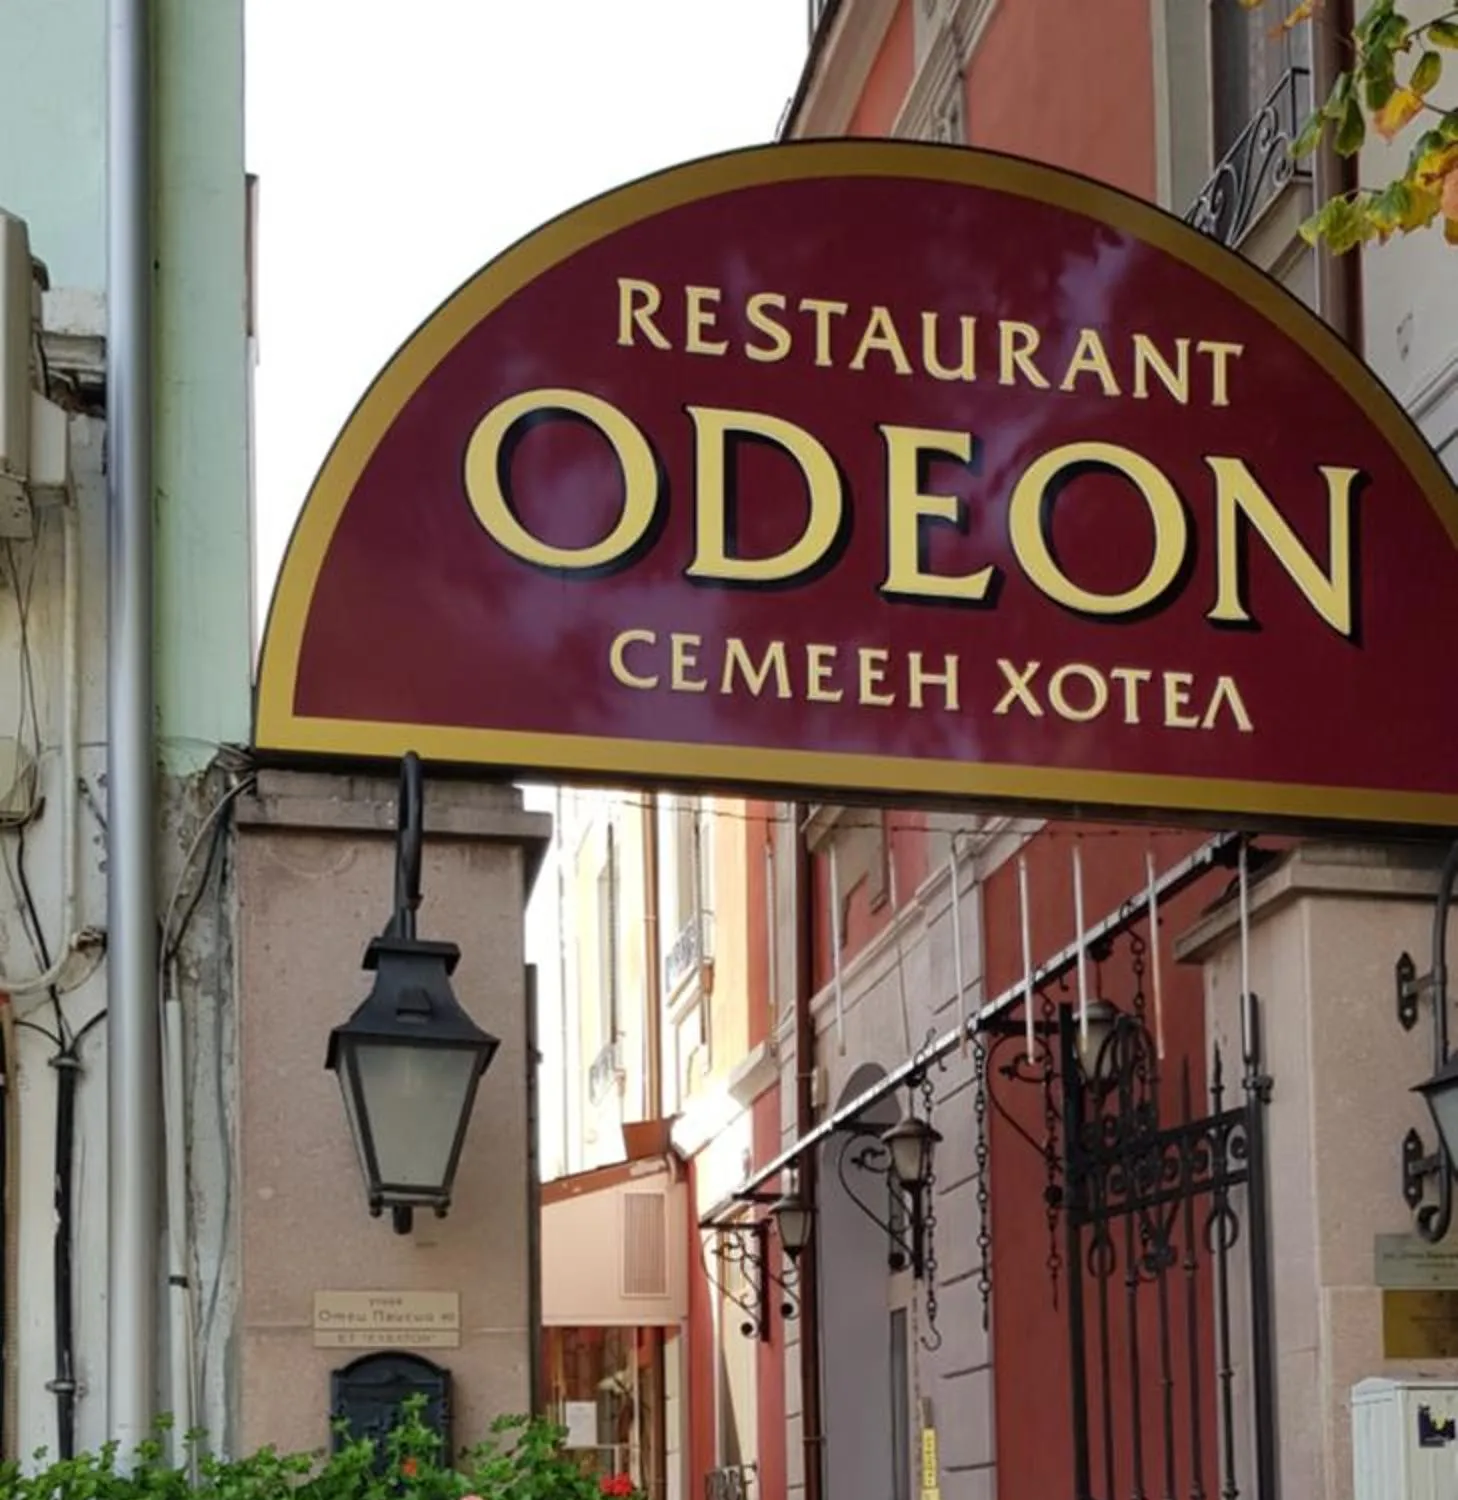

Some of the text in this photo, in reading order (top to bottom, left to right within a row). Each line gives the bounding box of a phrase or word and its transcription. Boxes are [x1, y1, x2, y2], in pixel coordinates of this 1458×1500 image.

[617, 278, 1243, 406] RESTAURANT
[464, 388, 1362, 640] ODEON
[609, 629, 1253, 732] СЕМЕЕН ХОТЕЛ
